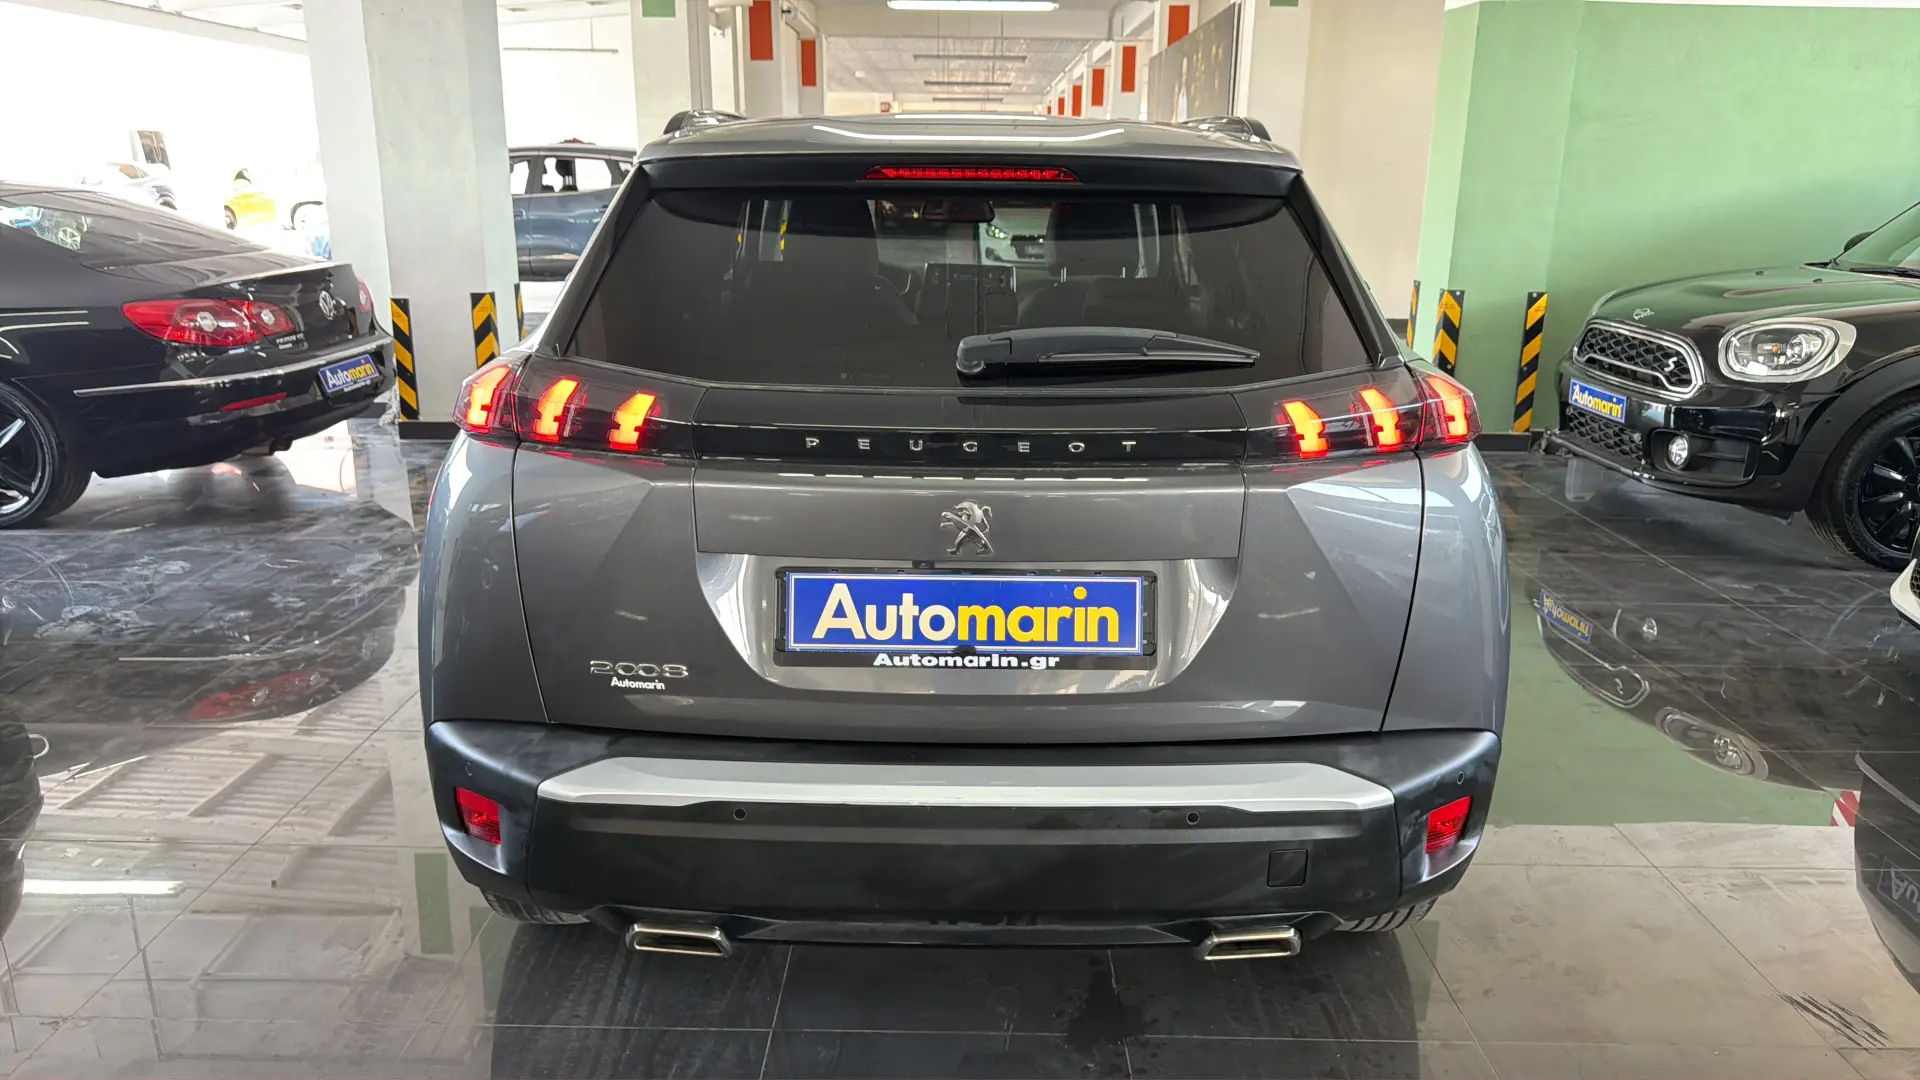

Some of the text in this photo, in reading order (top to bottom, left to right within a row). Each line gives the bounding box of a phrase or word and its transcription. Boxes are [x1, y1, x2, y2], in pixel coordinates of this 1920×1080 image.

[326, 359, 375, 388] Automarin
[1572, 384, 1622, 418] Automarin
[805, 437, 1137, 453] PEUGEOT
[812, 583, 1119, 642] Automarin
[590, 660, 688, 678] 2008
[873, 653, 1060, 669] Automarin.gr
[611, 676, 665, 690] Automarin
